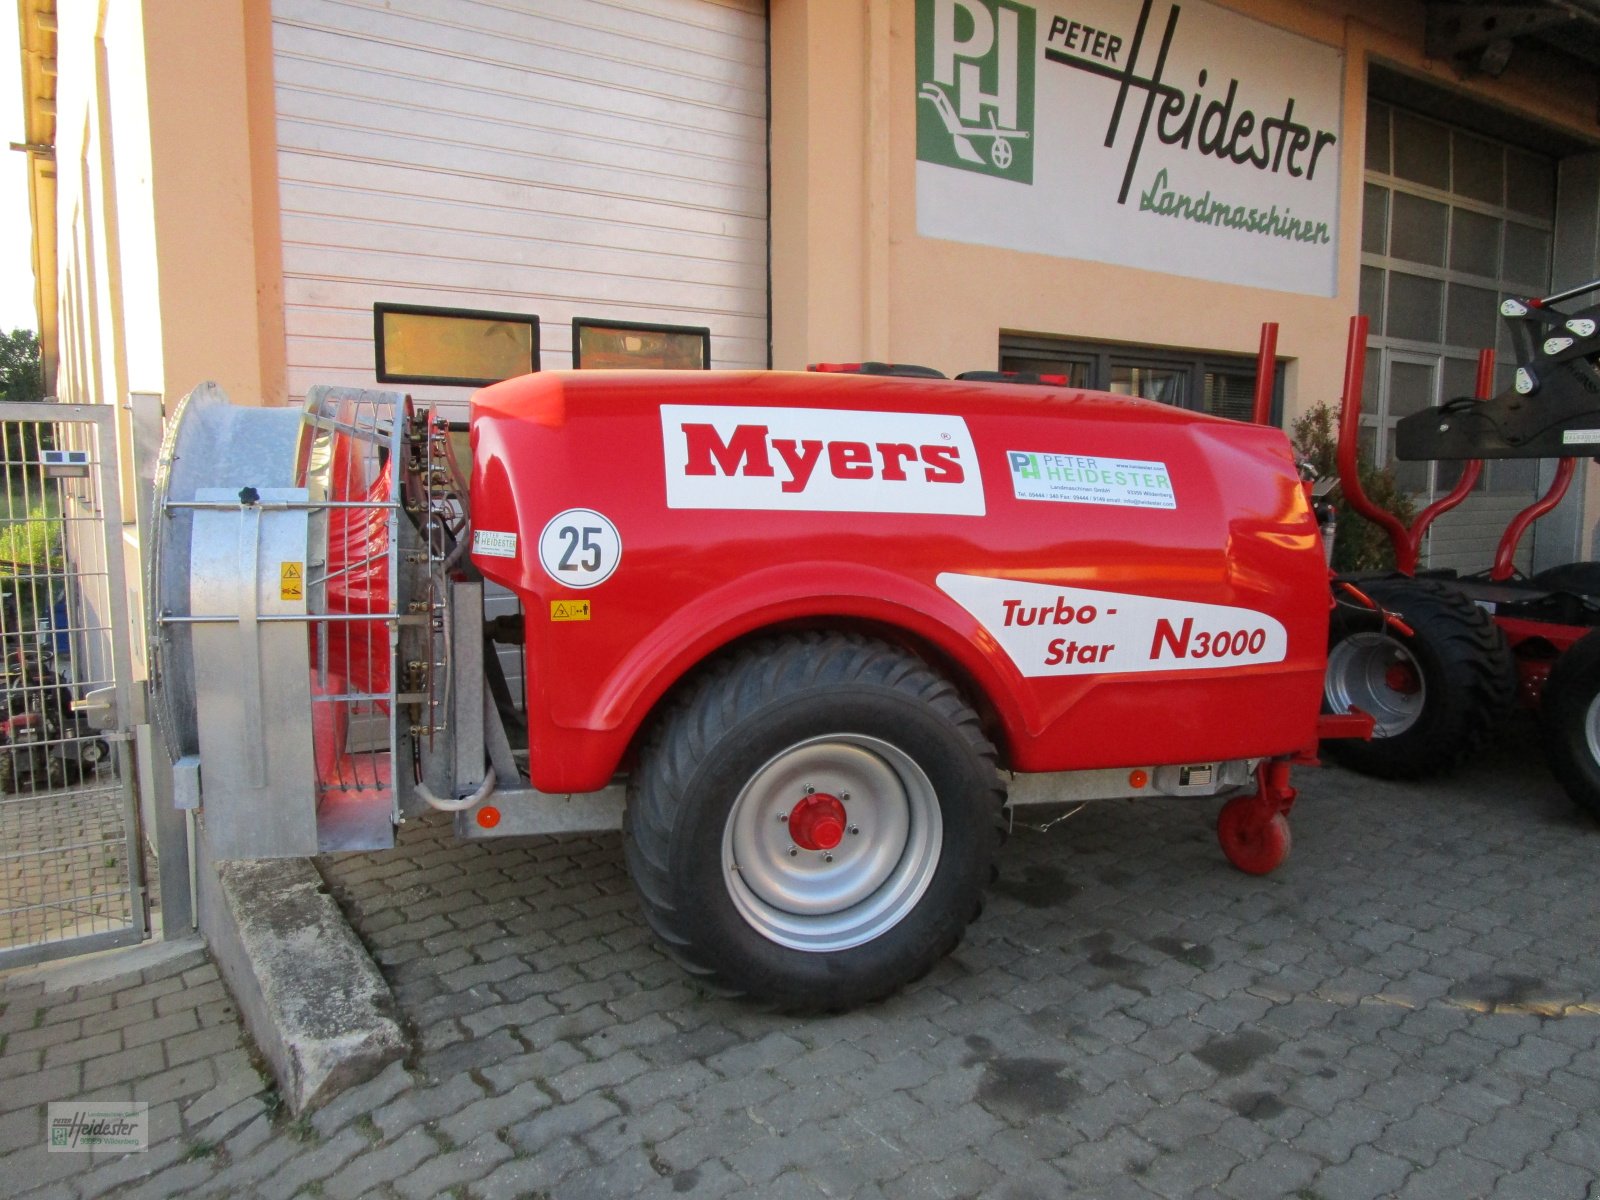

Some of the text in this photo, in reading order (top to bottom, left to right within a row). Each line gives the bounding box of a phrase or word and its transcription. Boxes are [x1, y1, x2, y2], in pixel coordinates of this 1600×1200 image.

[1048, 0, 1337, 206] PETER Heidester
[1139, 167, 1331, 245] Landmaschinen
[1043, 455, 1098, 469] PETER
[1047, 466, 1170, 489] HEIDESTER
[481, 537, 516, 548] HEIDESTER
[558, 526, 603, 573] 25
[1002, 596, 1097, 627] Turbo
[1044, 637, 1116, 666] Star
[1149, 617, 1267, 660] N3000
